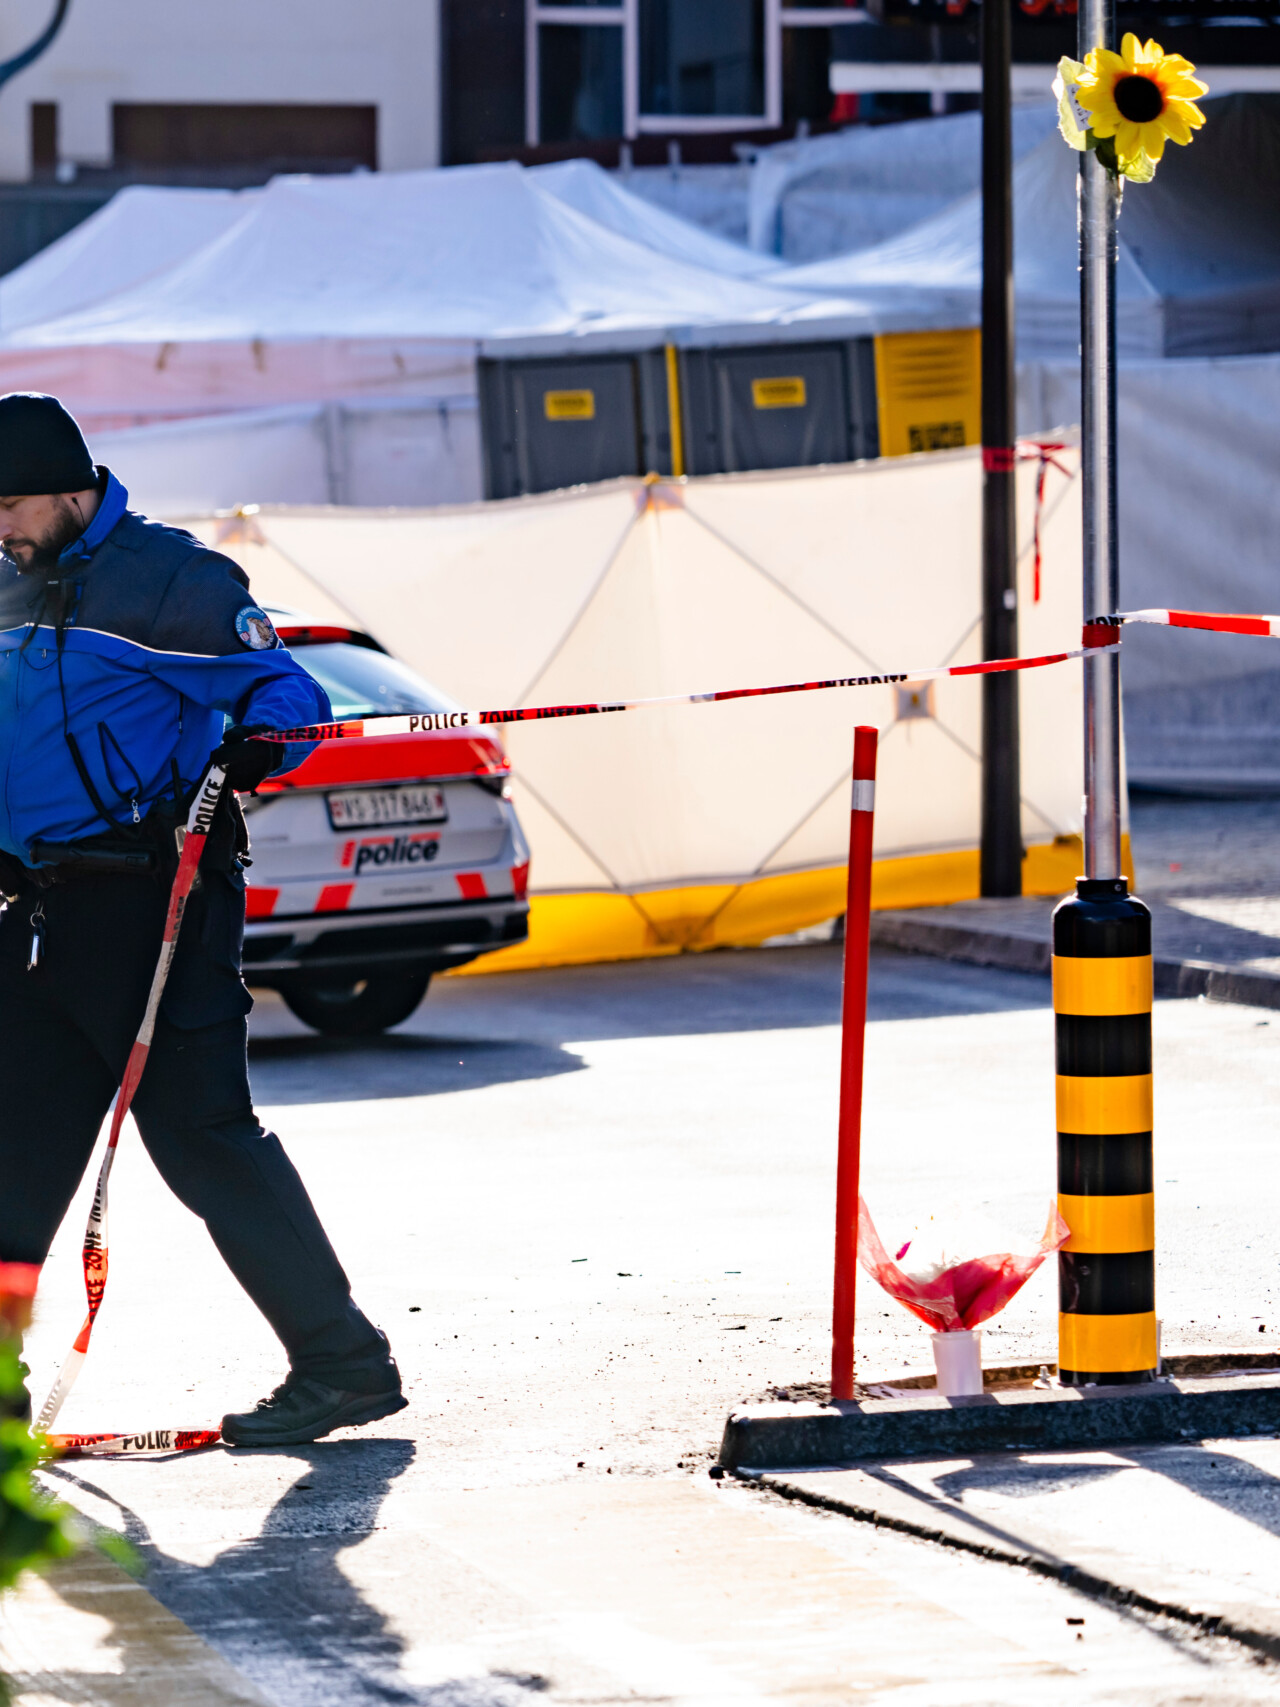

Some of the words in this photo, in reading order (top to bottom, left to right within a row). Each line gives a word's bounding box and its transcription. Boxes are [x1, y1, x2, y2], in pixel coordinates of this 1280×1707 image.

[409, 703, 469, 733] POLICE
[479, 709, 524, 724] ZONE
[192, 777, 222, 835] POLICE
[354, 836, 439, 875] police
[84, 1229, 102, 1271] ZONE
[123, 1430, 172, 1450] POLICE
